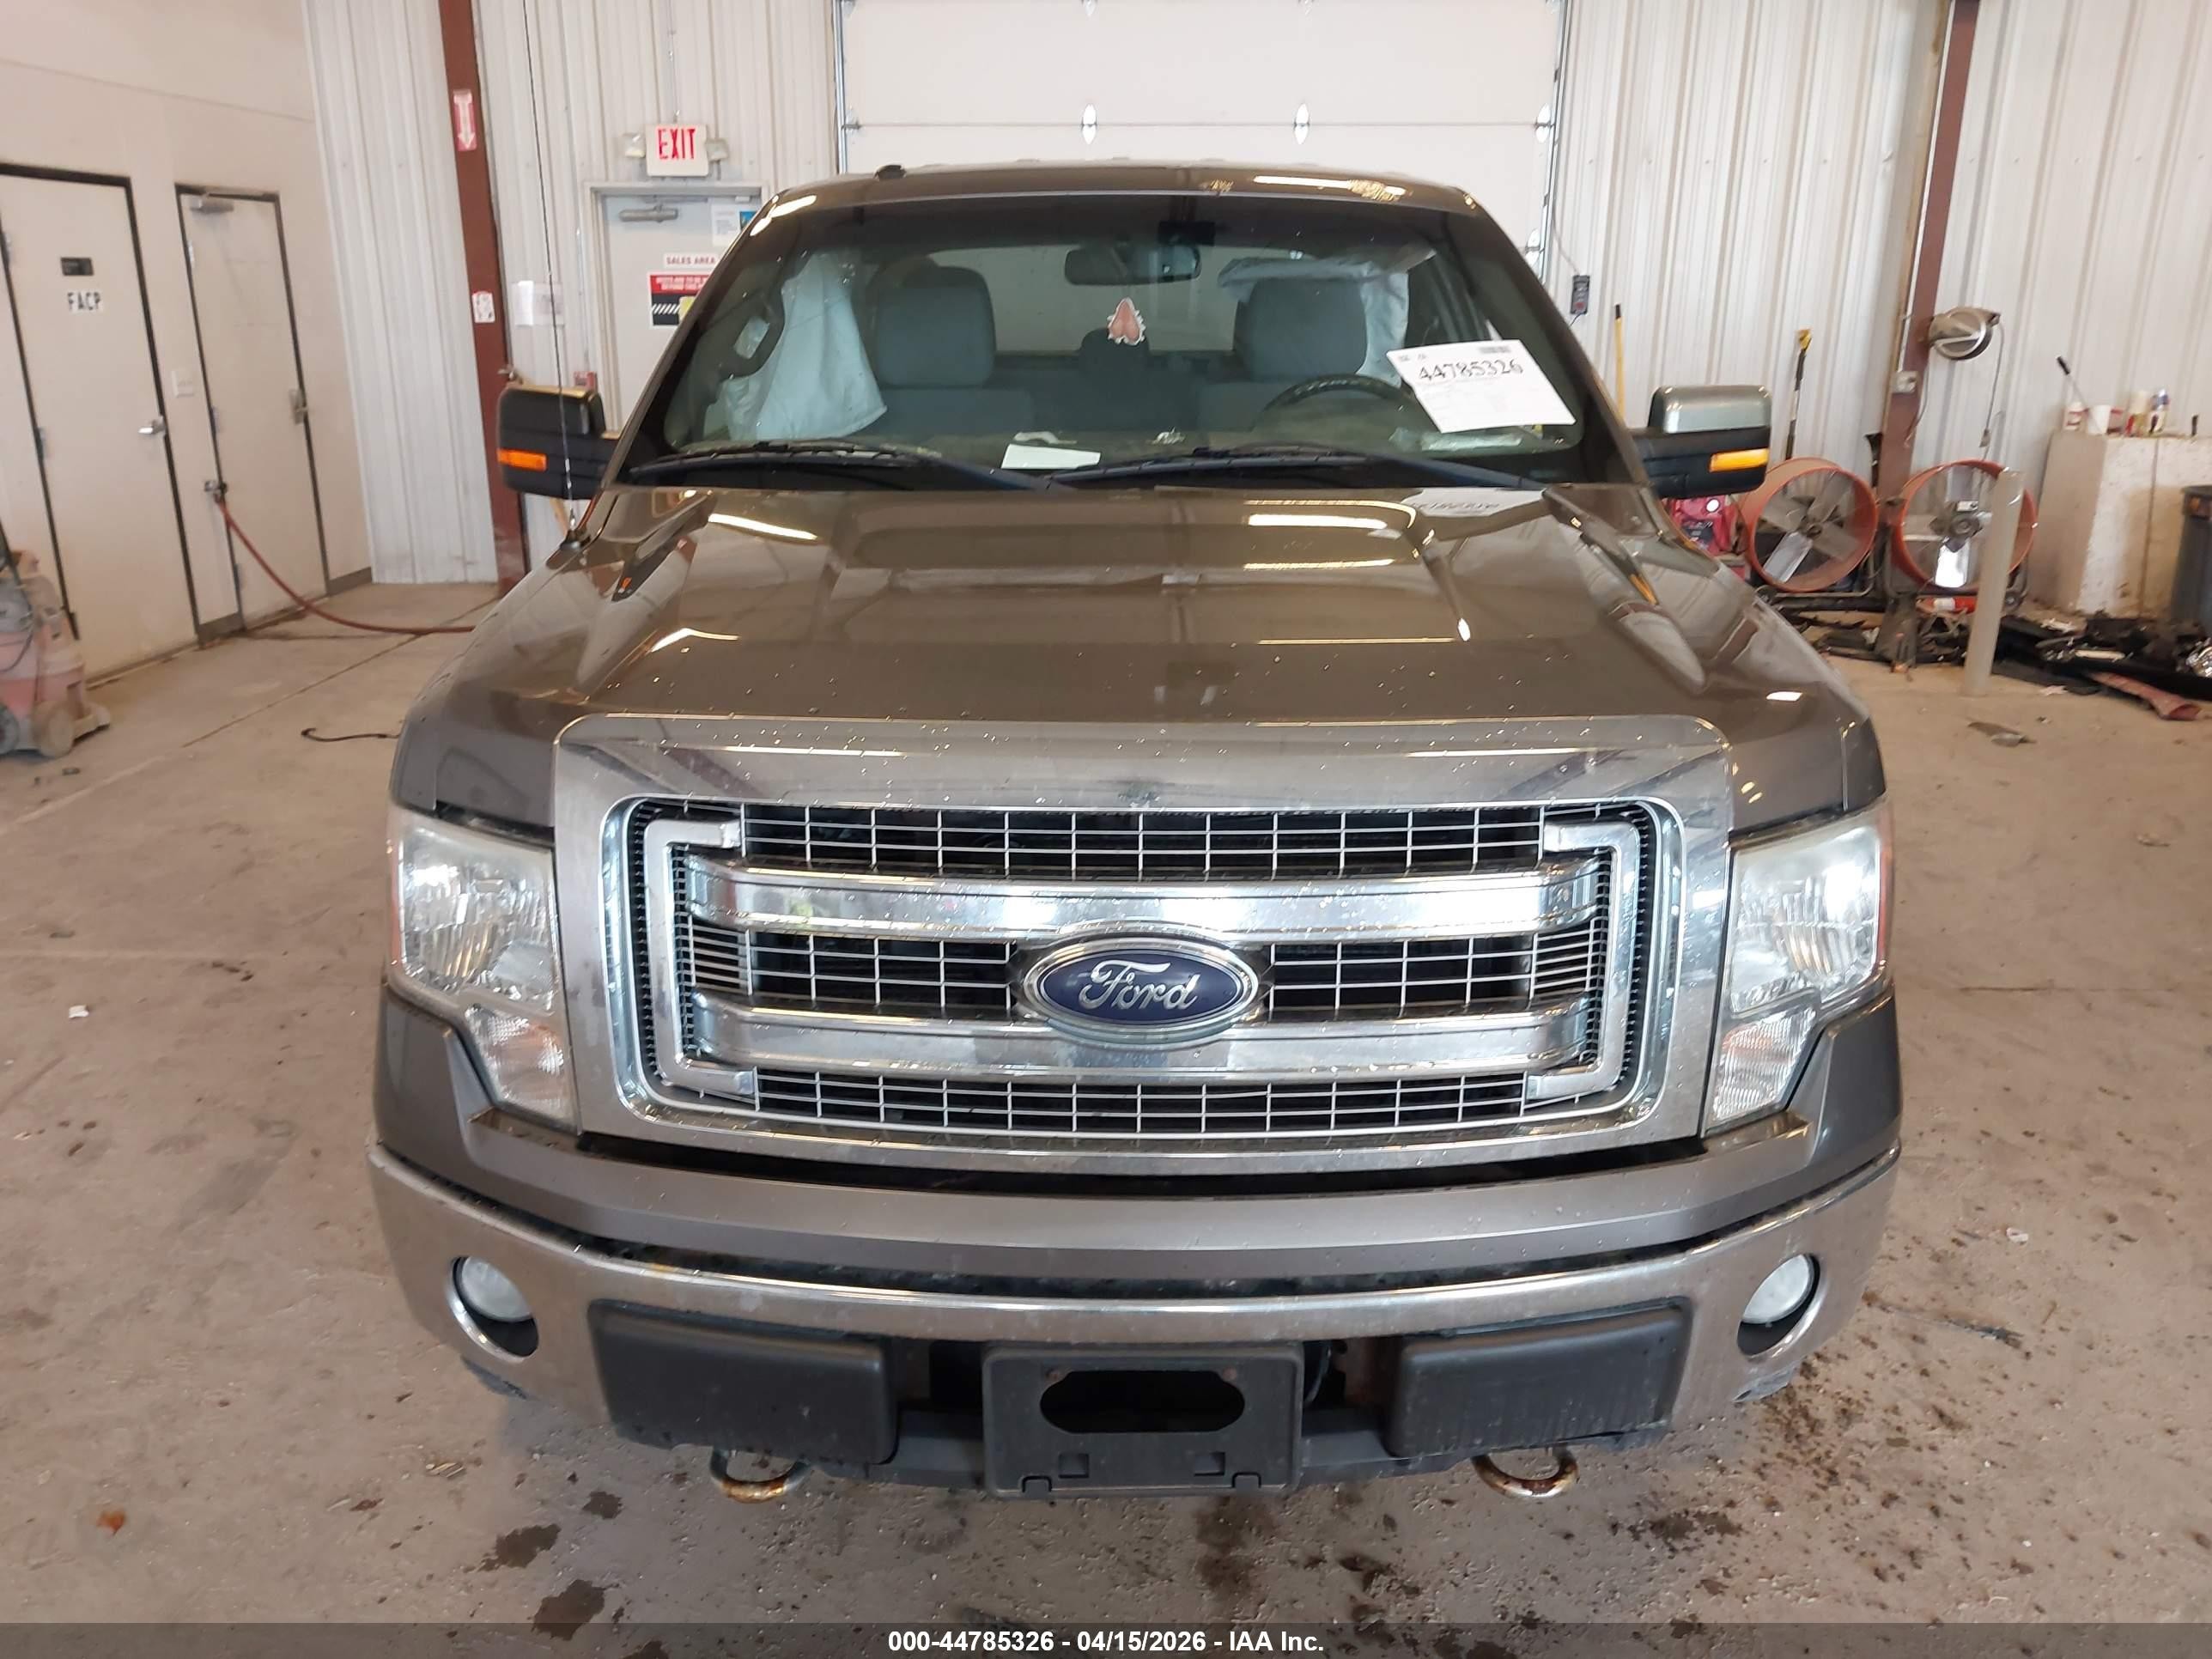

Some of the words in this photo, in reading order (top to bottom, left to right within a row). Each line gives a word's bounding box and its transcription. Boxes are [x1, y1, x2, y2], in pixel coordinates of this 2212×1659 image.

[658, 128, 696, 160] EXIT
[1419, 359, 1524, 380] 44785326
[1079, 959, 1201, 1011] Ford
